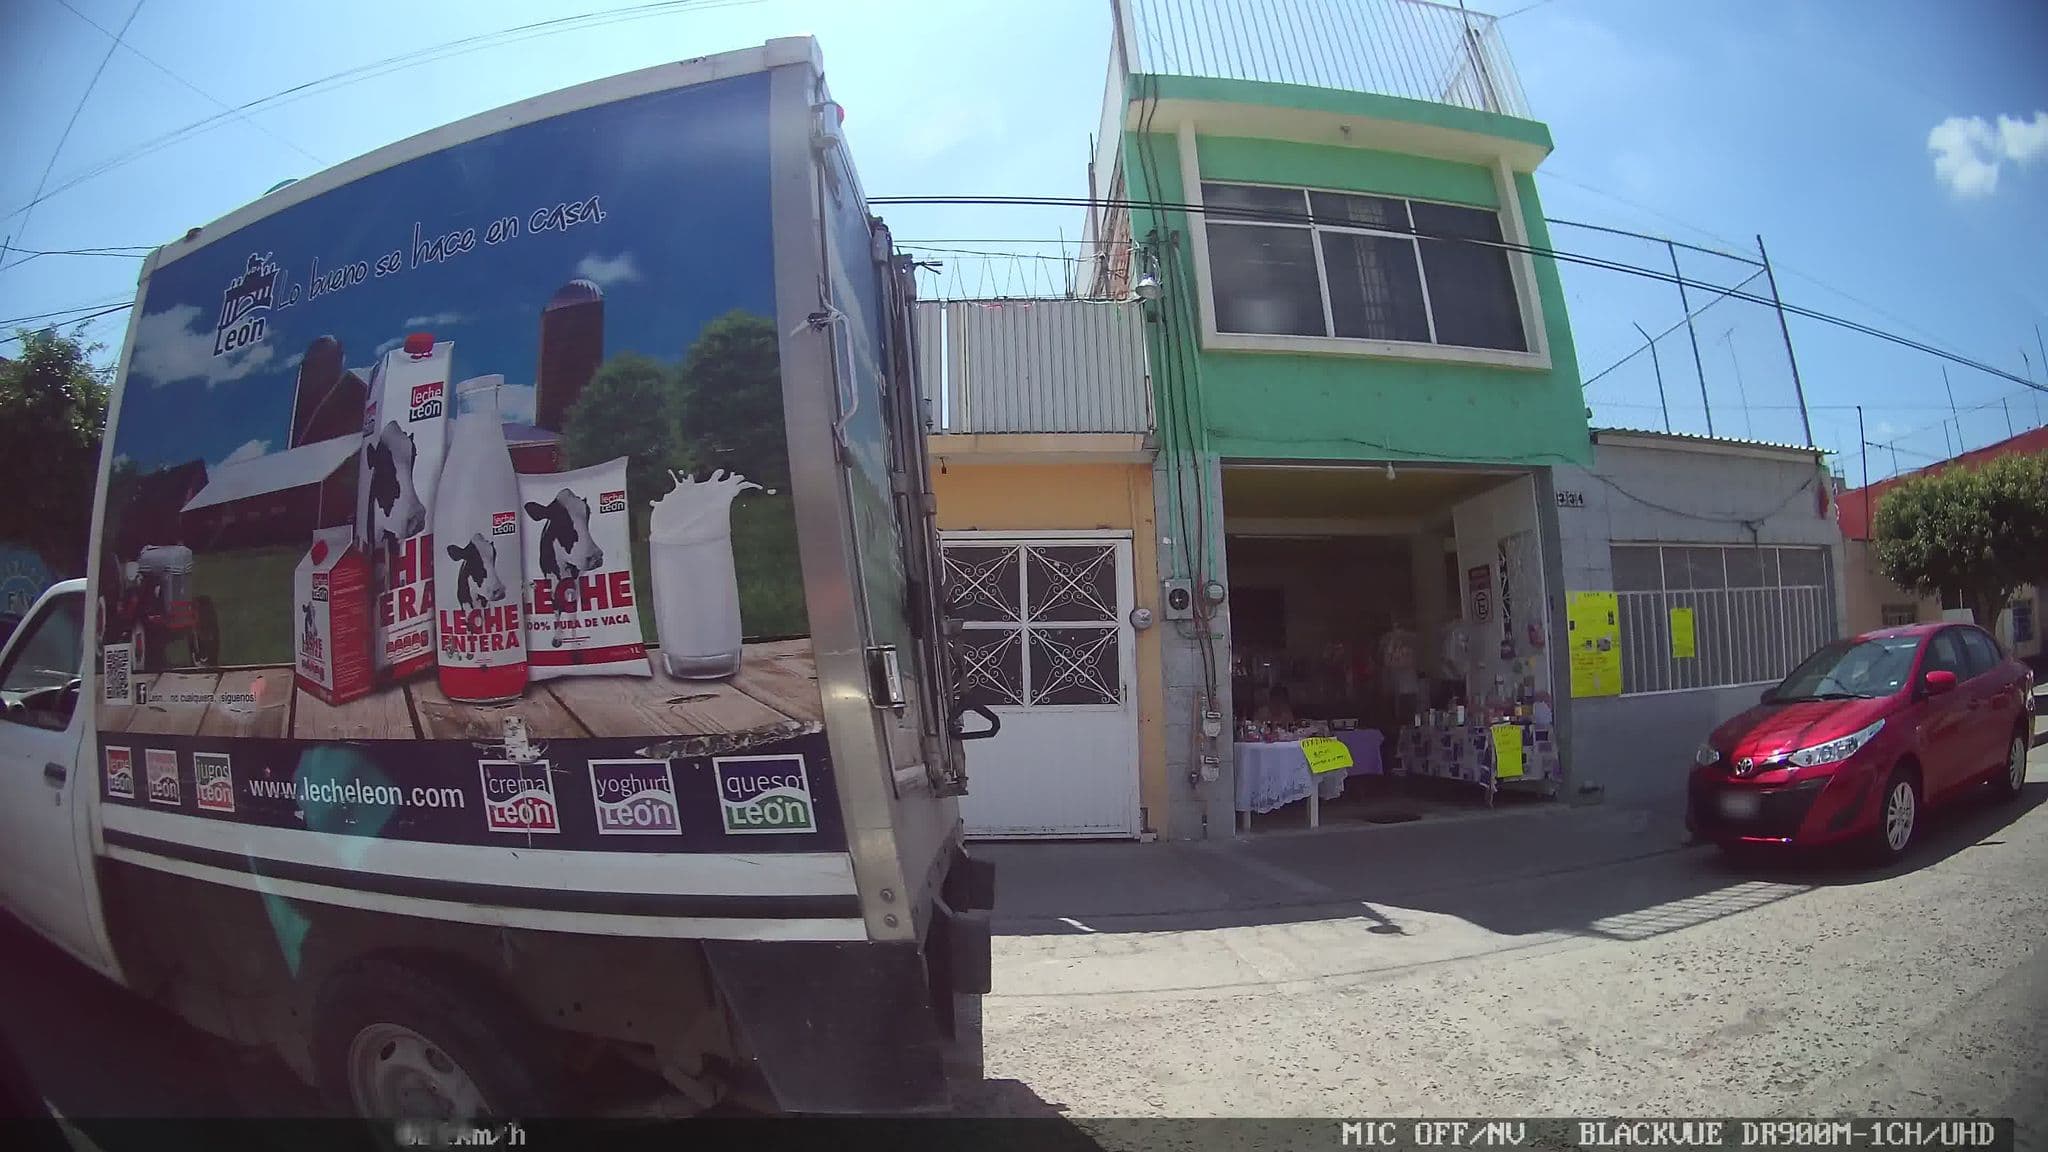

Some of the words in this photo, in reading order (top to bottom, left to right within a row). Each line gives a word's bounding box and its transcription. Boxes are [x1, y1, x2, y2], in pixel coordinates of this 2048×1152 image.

[277, 269, 301, 311] Lo
[308, 256, 368, 301] bueno
[374, 249, 401, 278] se
[411, 221, 475, 269] hace
[485, 216, 519, 245] en
[528, 194, 607, 233] casa.
[413, 386, 441, 405] leche
[524, 570, 634, 615] ECHE
[440, 604, 519, 635] LECHE
[527, 621, 551, 631] 00%
[584, 618, 598, 628] DE
[601, 614, 631, 626] VACA
[441, 631, 520, 653] ENTERA
[197, 759, 229, 784] jugos
[249, 777, 465, 809] www.lecheleon.com
[489, 775, 547, 795] crema
[596, 773, 671, 798] yoghurt
[727, 773, 803, 798] queso
